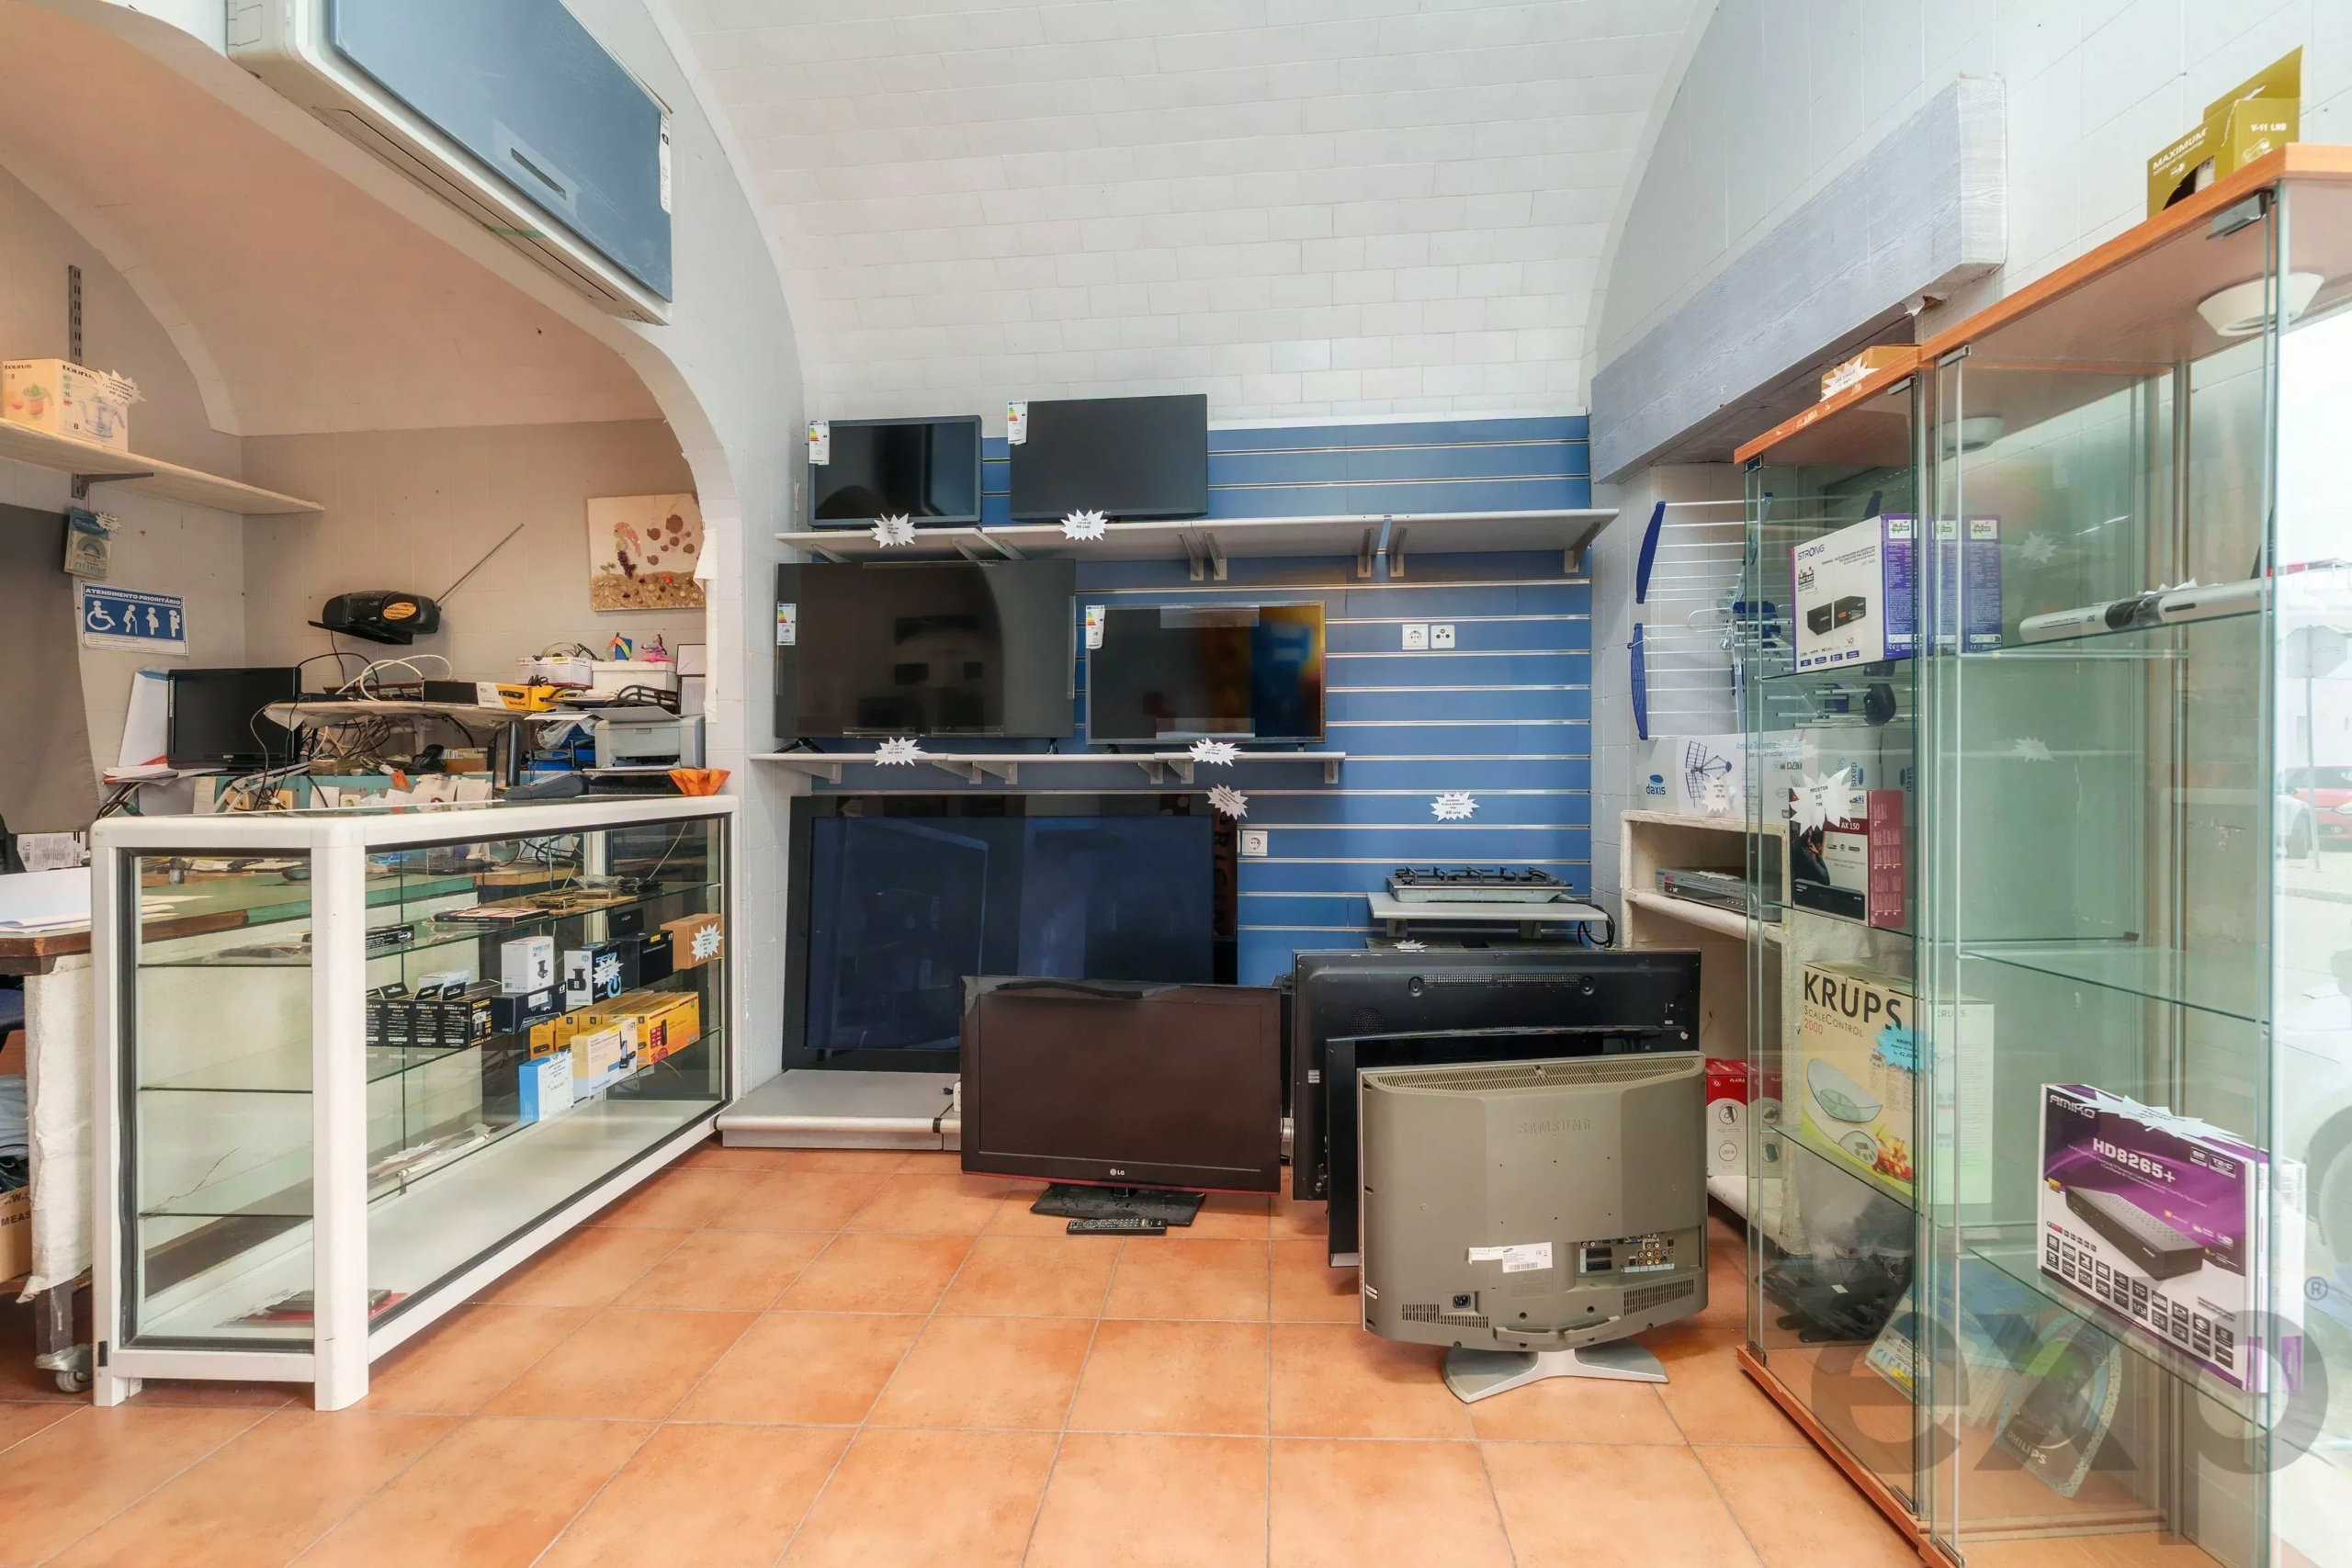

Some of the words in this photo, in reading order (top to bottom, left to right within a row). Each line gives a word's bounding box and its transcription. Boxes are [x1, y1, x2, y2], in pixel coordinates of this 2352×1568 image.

[2251, 123, 2268, 132] V-11
[2270, 122, 2288, 131] LNB
[2153, 127, 2208, 171] MAXIMUM
[1797, 544, 1825, 561] STRONG
[74, 561, 107, 575] CLEANING
[85, 588, 138, 600] ATENDIMENTO
[139, 594, 181, 605] PRIORITÁRIO
[1645, 784, 1667, 795] daxis
[1804, 971, 1903, 1032] KRUPS
[1938, 1010, 1966, 1018] KRUS
[1804, 1018, 1824, 1035] 2000
[2050, 1094, 2098, 1119] AMIKO
[1518, 1118, 1591, 1134] SAMSUNG
[2092, 1137, 2176, 1183] HD8265+
[2007, 1430, 2047, 1464] PHILIPS
